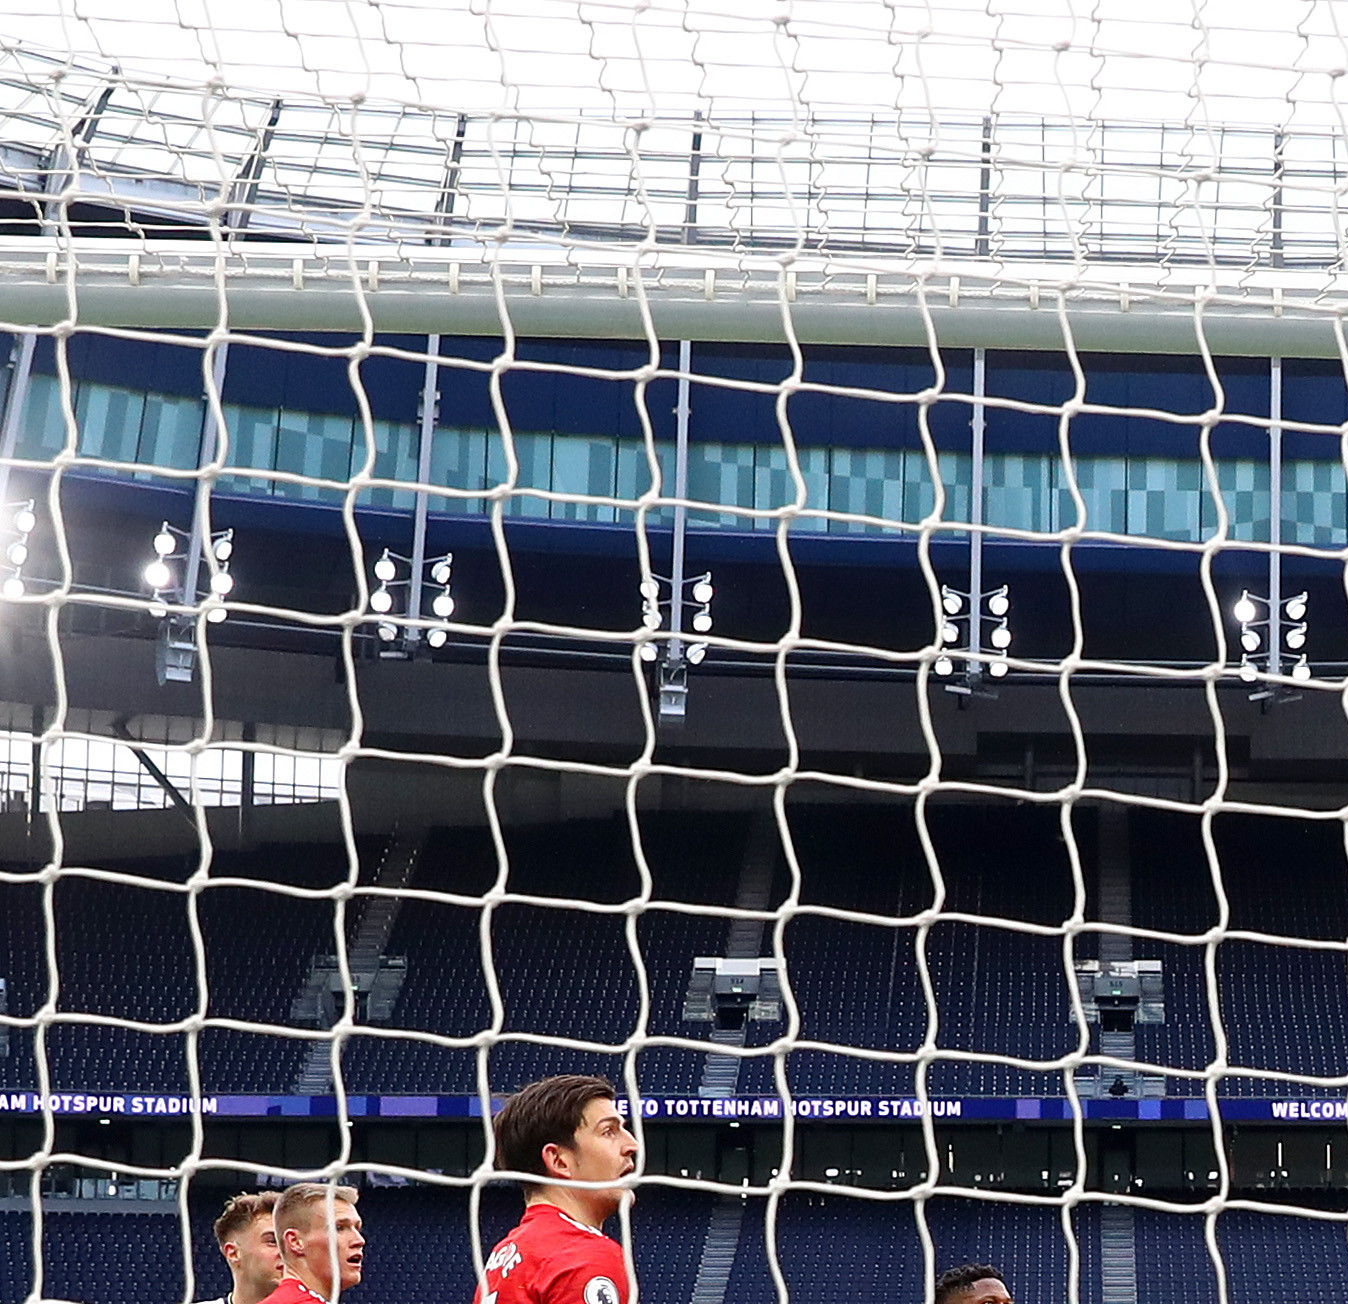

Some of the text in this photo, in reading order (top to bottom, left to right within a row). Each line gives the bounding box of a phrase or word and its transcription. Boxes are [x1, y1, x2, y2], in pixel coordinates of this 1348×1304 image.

[33, 1094, 126, 1113] HOTSPUR
[635, 1099, 658, 1115] TO
[665, 1099, 779, 1116] TOTTENHAM
[787, 1099, 872, 1117] HOTSPUR
[878, 1100, 962, 1118] STADIUM
